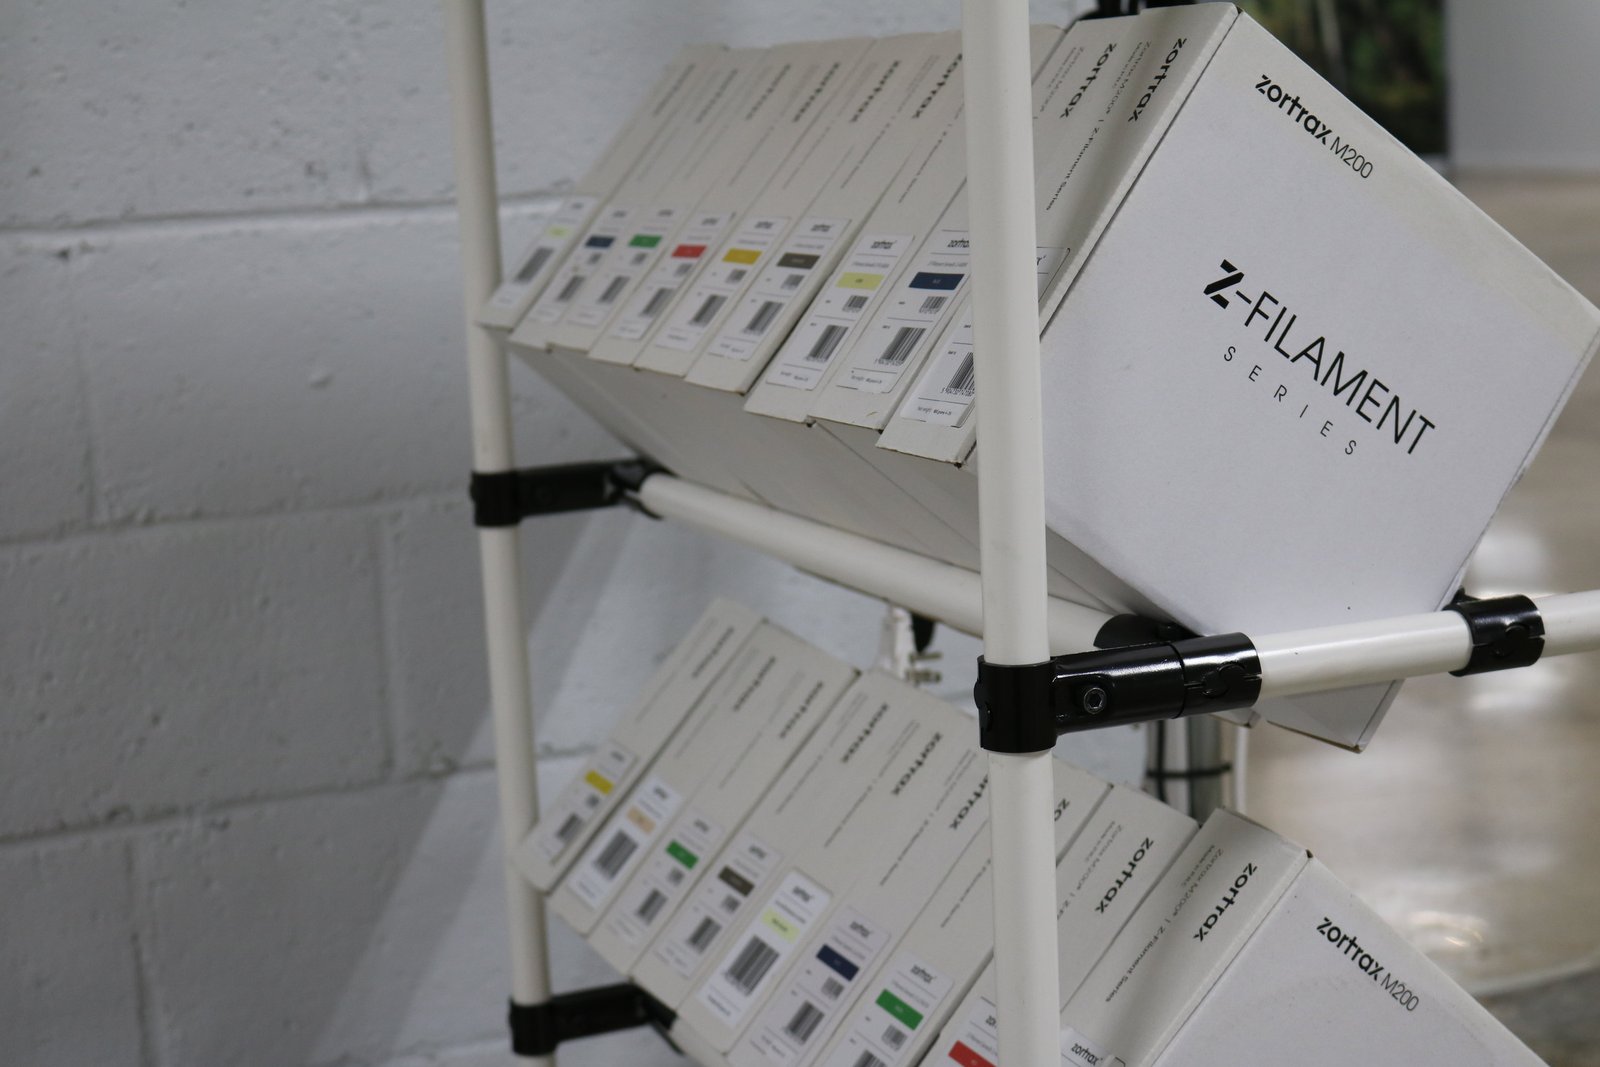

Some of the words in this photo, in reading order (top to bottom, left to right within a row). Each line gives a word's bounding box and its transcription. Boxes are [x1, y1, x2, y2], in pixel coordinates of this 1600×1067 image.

[1060, 42, 1117, 119] zortrax
[1128, 37, 1187, 122] zortrax
[1255, 74, 1332, 145] zortrax
[1330, 136, 1373, 179] M200
[1203, 259, 1436, 455] Z-FILAMENT
[1224, 346, 1357, 456] SERIES
[1095, 837, 1154, 914] zortrax
[1193, 862, 1258, 942] zortrax
[1316, 917, 1384, 981] zortrax
[1380, 973, 1419, 1011] M200
